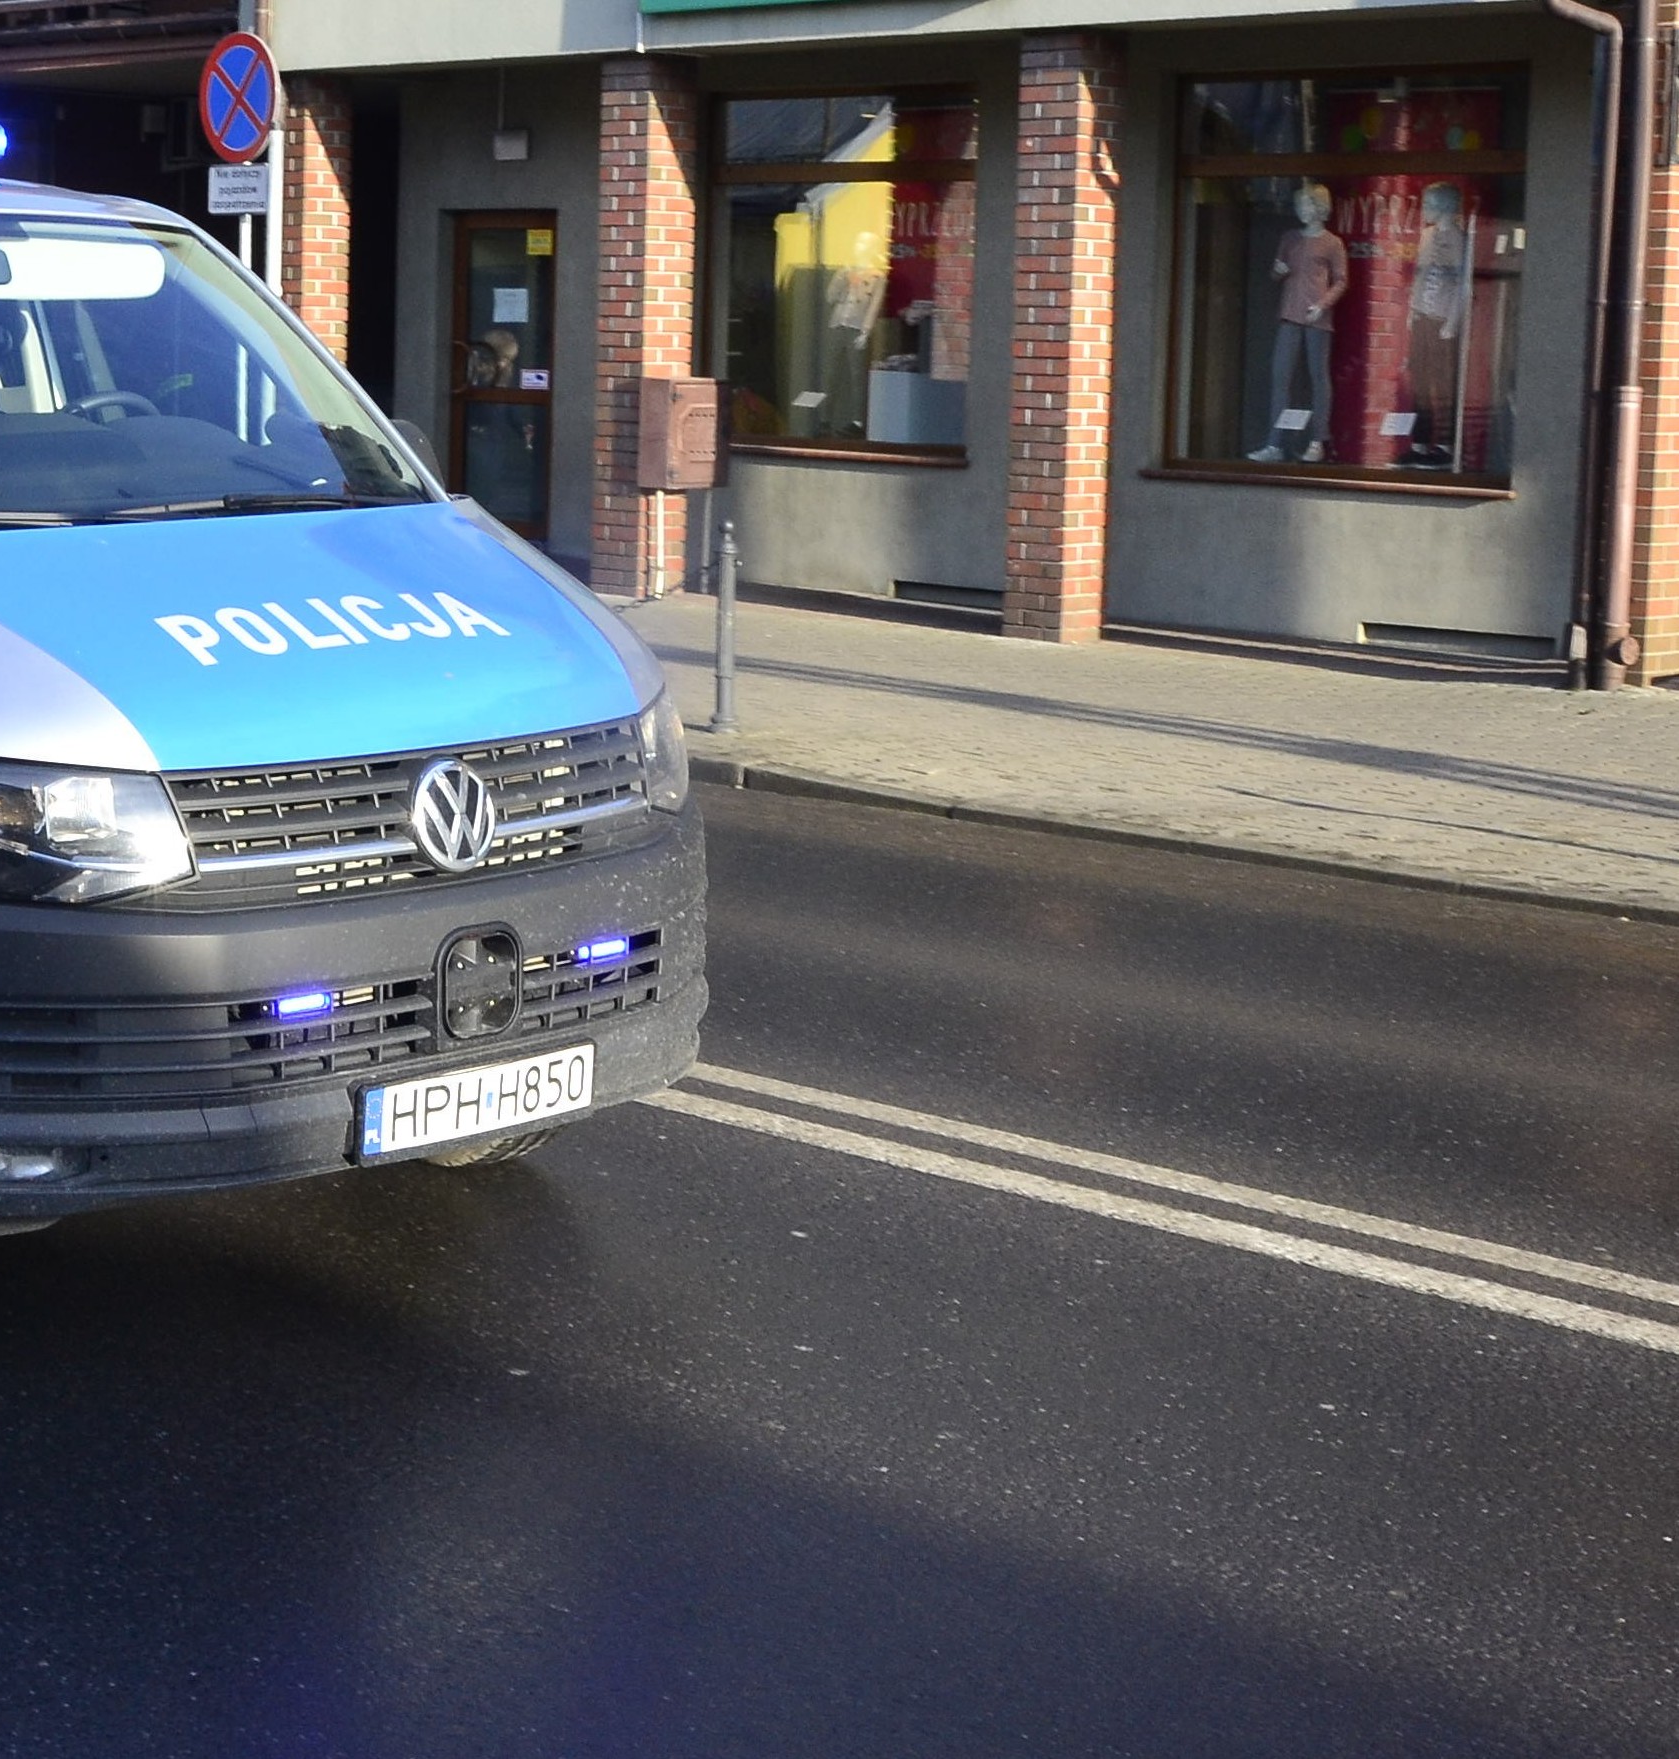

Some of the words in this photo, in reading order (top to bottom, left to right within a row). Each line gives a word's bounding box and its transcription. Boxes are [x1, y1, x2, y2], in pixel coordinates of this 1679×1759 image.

[153, 591, 512, 667] POLICJA
[391, 1077, 483, 1142] HPH
[497, 1055, 585, 1120] H850
